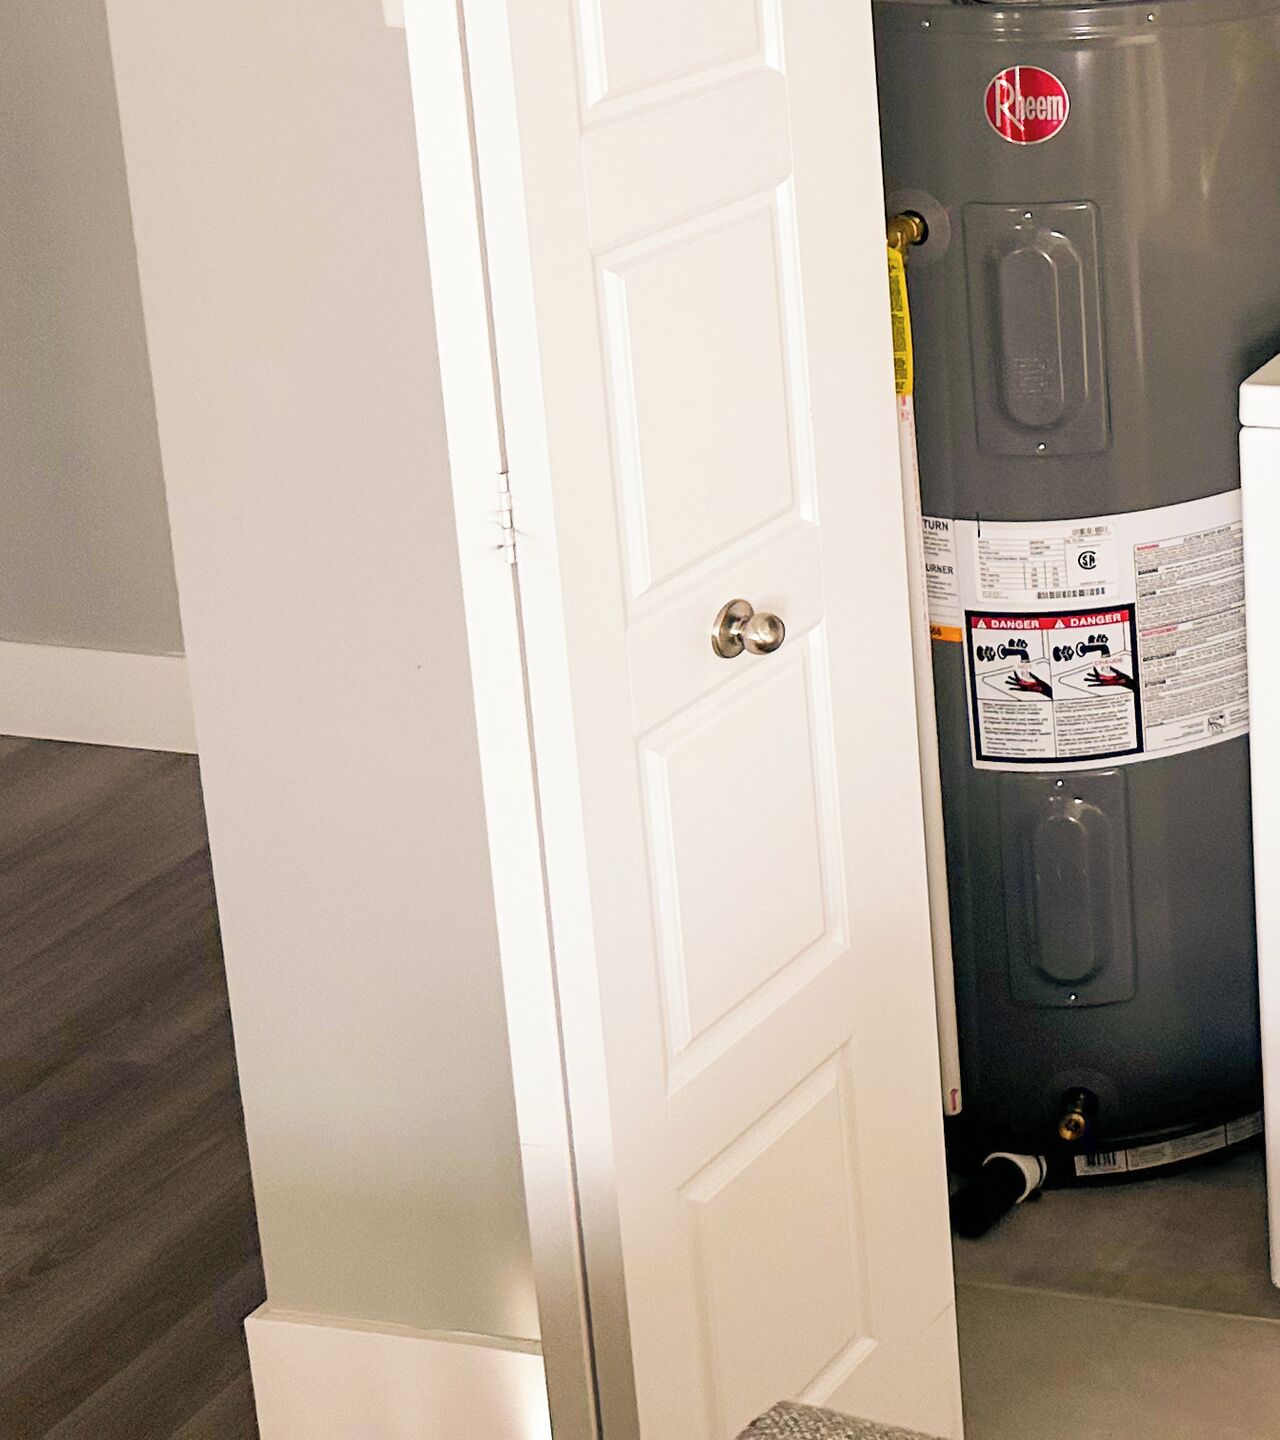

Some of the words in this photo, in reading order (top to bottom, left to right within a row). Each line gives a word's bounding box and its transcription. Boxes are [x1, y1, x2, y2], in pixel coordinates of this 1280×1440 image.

[994, 66, 1064, 132] Rheem
[990, 619, 1040, 629] DANGER
[1070, 613, 1122, 627] DANGER
